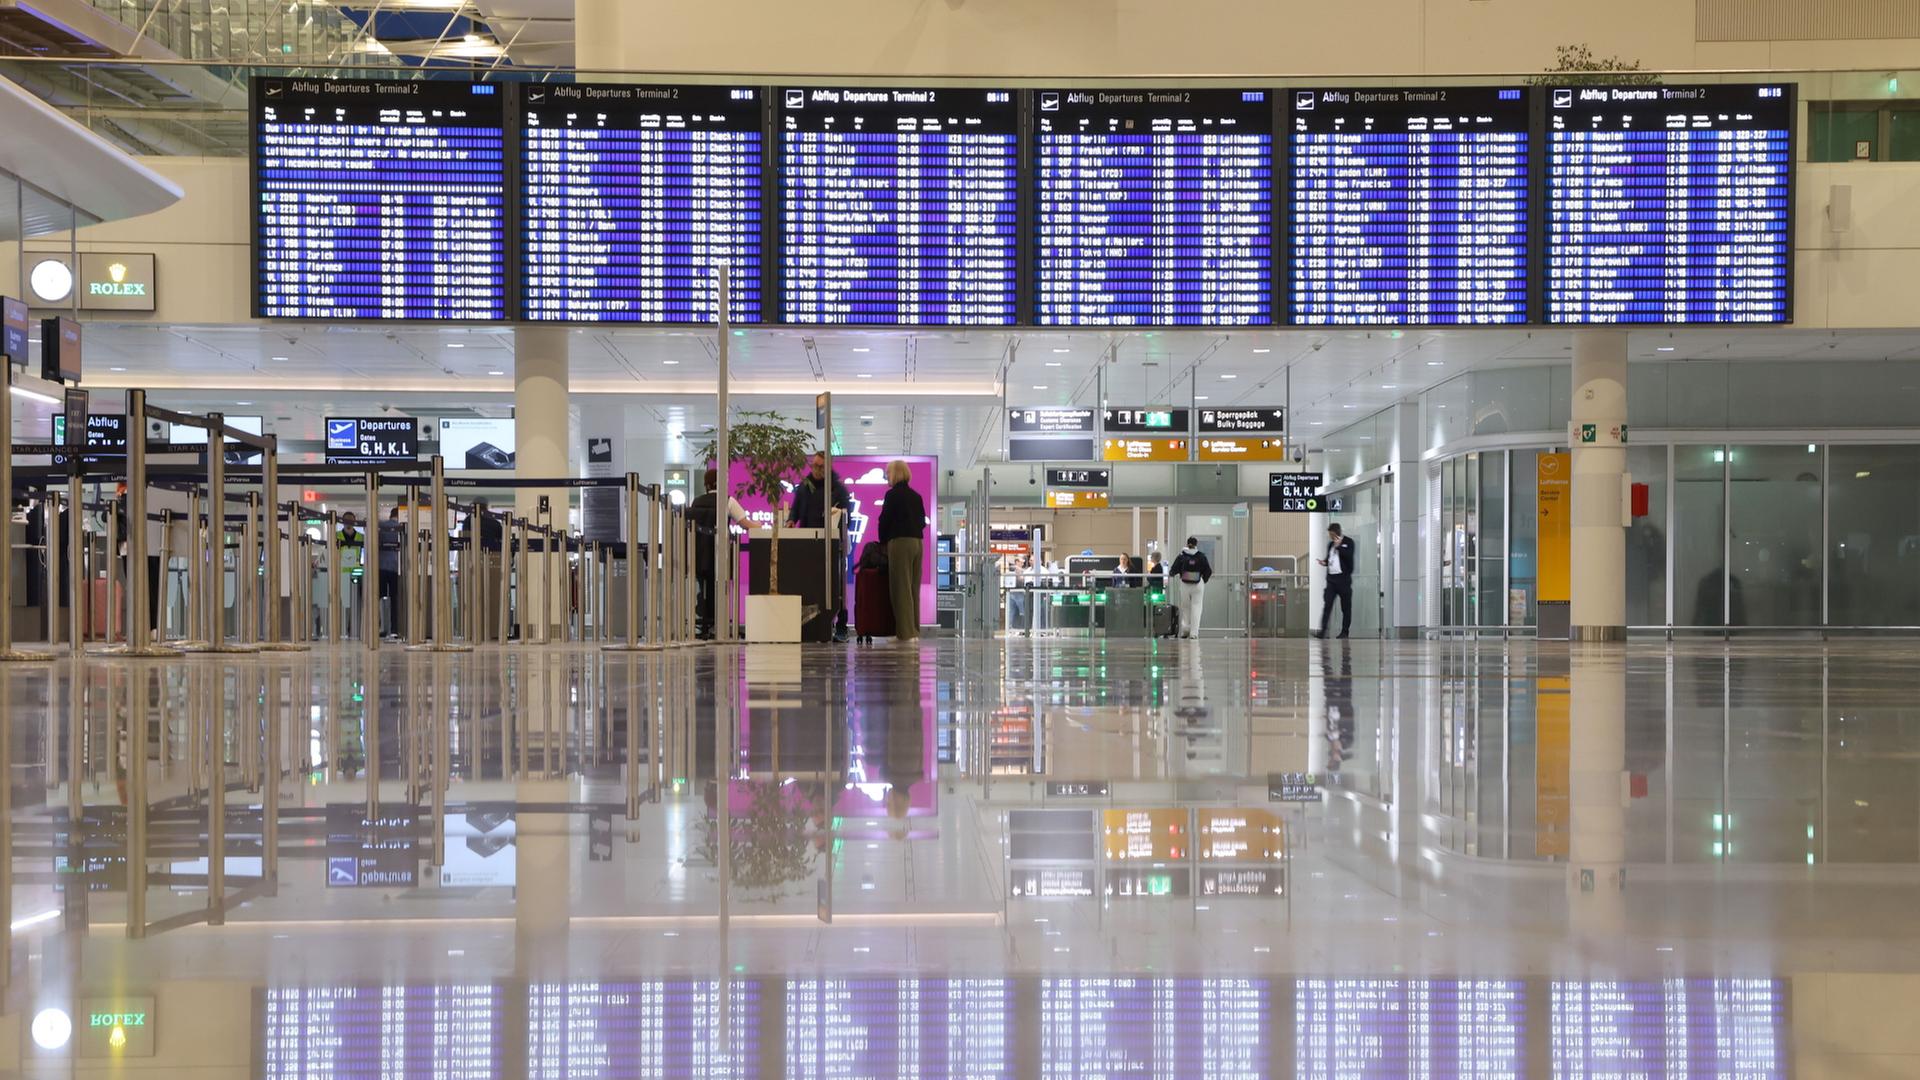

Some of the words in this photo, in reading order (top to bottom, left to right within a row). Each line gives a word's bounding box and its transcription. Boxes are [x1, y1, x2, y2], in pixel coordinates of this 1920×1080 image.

[292, 82, 319, 94] Abflug
[324, 82, 370, 94] Departures
[375, 84, 410, 94] Terminal
[412, 84, 418, 94] 2
[554, 87, 581, 98] Abflug
[586, 87, 631, 98] Departures
[636, 88, 670, 98] Terminal
[672, 89, 678, 99] 2
[812, 91, 839, 102] Abflug
[844, 91, 888, 102] Departures
[892, 92, 927, 102] Terminal
[929, 92, 935, 102] 2
[1068, 93, 1094, 104] Abflug
[1098, 93, 1143, 104] Departures
[1148, 93, 1182, 102] Terminal
[1184, 93, 1190, 102] 2
[1323, 92, 1349, 103] Abflug
[1354, 92, 1398, 102] Departures
[1404, 92, 1438, 101] Terminal
[1440, 92, 1446, 101] 2
[1580, 90, 1607, 101] Abflug
[1612, 89, 1658, 100] Departures
[1662, 88, 1697, 98] Terminal
[1700, 88, 1705, 98] 2
[266, 124, 279, 133] Due
[283, 125, 292, 133] to
[305, 125, 332, 134] strike
[336, 126, 354, 134] call
[371, 127, 385, 135] the
[389, 127, 411, 136] trade
[415, 128, 437, 136] union
[354, 138, 380, 146] severe
[437, 140, 446, 148] in
[1080, 135, 1105, 143] Berlin
[1220, 136, 1259, 144] Lufthansa
[367, 150, 393, 158] occur.
[965, 147, 1004, 155] Lufthansa
[283, 160, 341, 168] inconvenience
[345, 161, 376, 169] caused.
[1476, 168, 1515, 176] Lufthansa
[306, 228, 332, 237] Berlin
[306, 251, 333, 259] Zurich
[451, 254, 491, 262] Lufthansa
[90, 284, 145, 295] ROLEX
[306, 285, 328, 294] Turin
[1217, 411, 1258, 420] Sperrgepäck
[88, 416, 118, 429] Abflug
[360, 420, 411, 431] Departures
[1217, 420, 1235, 428] Bulky
[1237, 420, 1265, 429] Baggage
[361, 443, 372, 455] G,
[375, 443, 385, 455] H,
[389, 443, 399, 455] K,
[403, 443, 409, 454] L
[1283, 487, 1292, 496] G,
[1294, 487, 1302, 496] H,
[1304, 487, 1313, 496] K,
